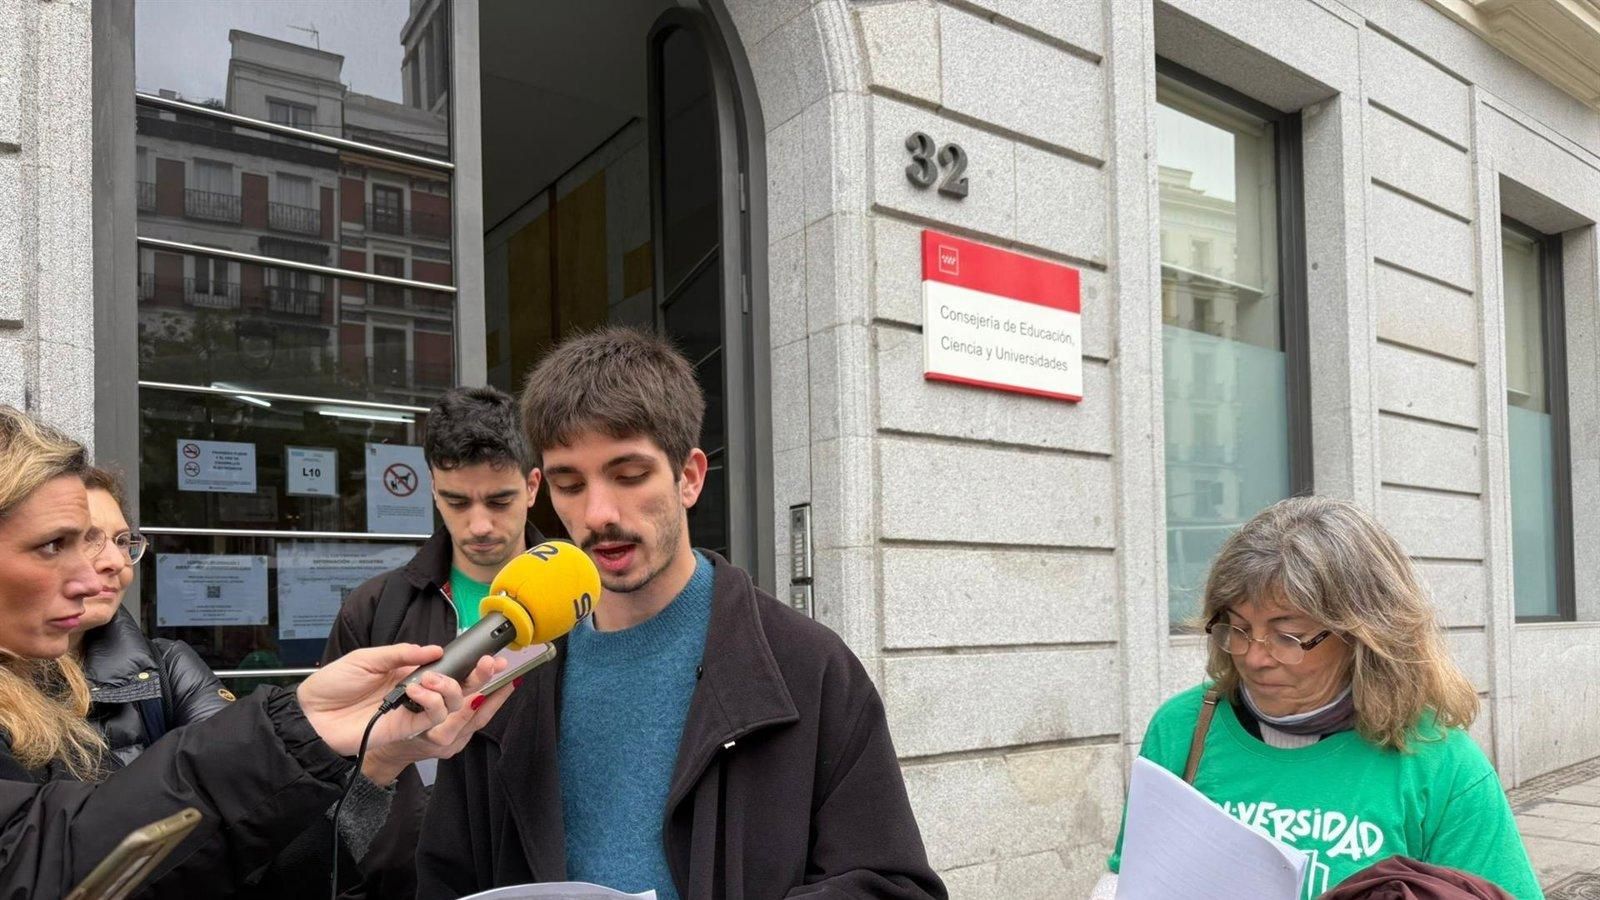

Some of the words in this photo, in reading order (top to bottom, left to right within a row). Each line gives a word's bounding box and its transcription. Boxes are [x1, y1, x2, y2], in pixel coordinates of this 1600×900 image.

[904, 127, 969, 201] 32
[1003, 319, 1017, 334] de
[1020, 321, 1076, 346] Educación,
[941, 336, 983, 357] Ciencia
[986, 346, 993, 361] y
[995, 347, 1068, 371] Universidades
[302, 467, 322, 478] L10
